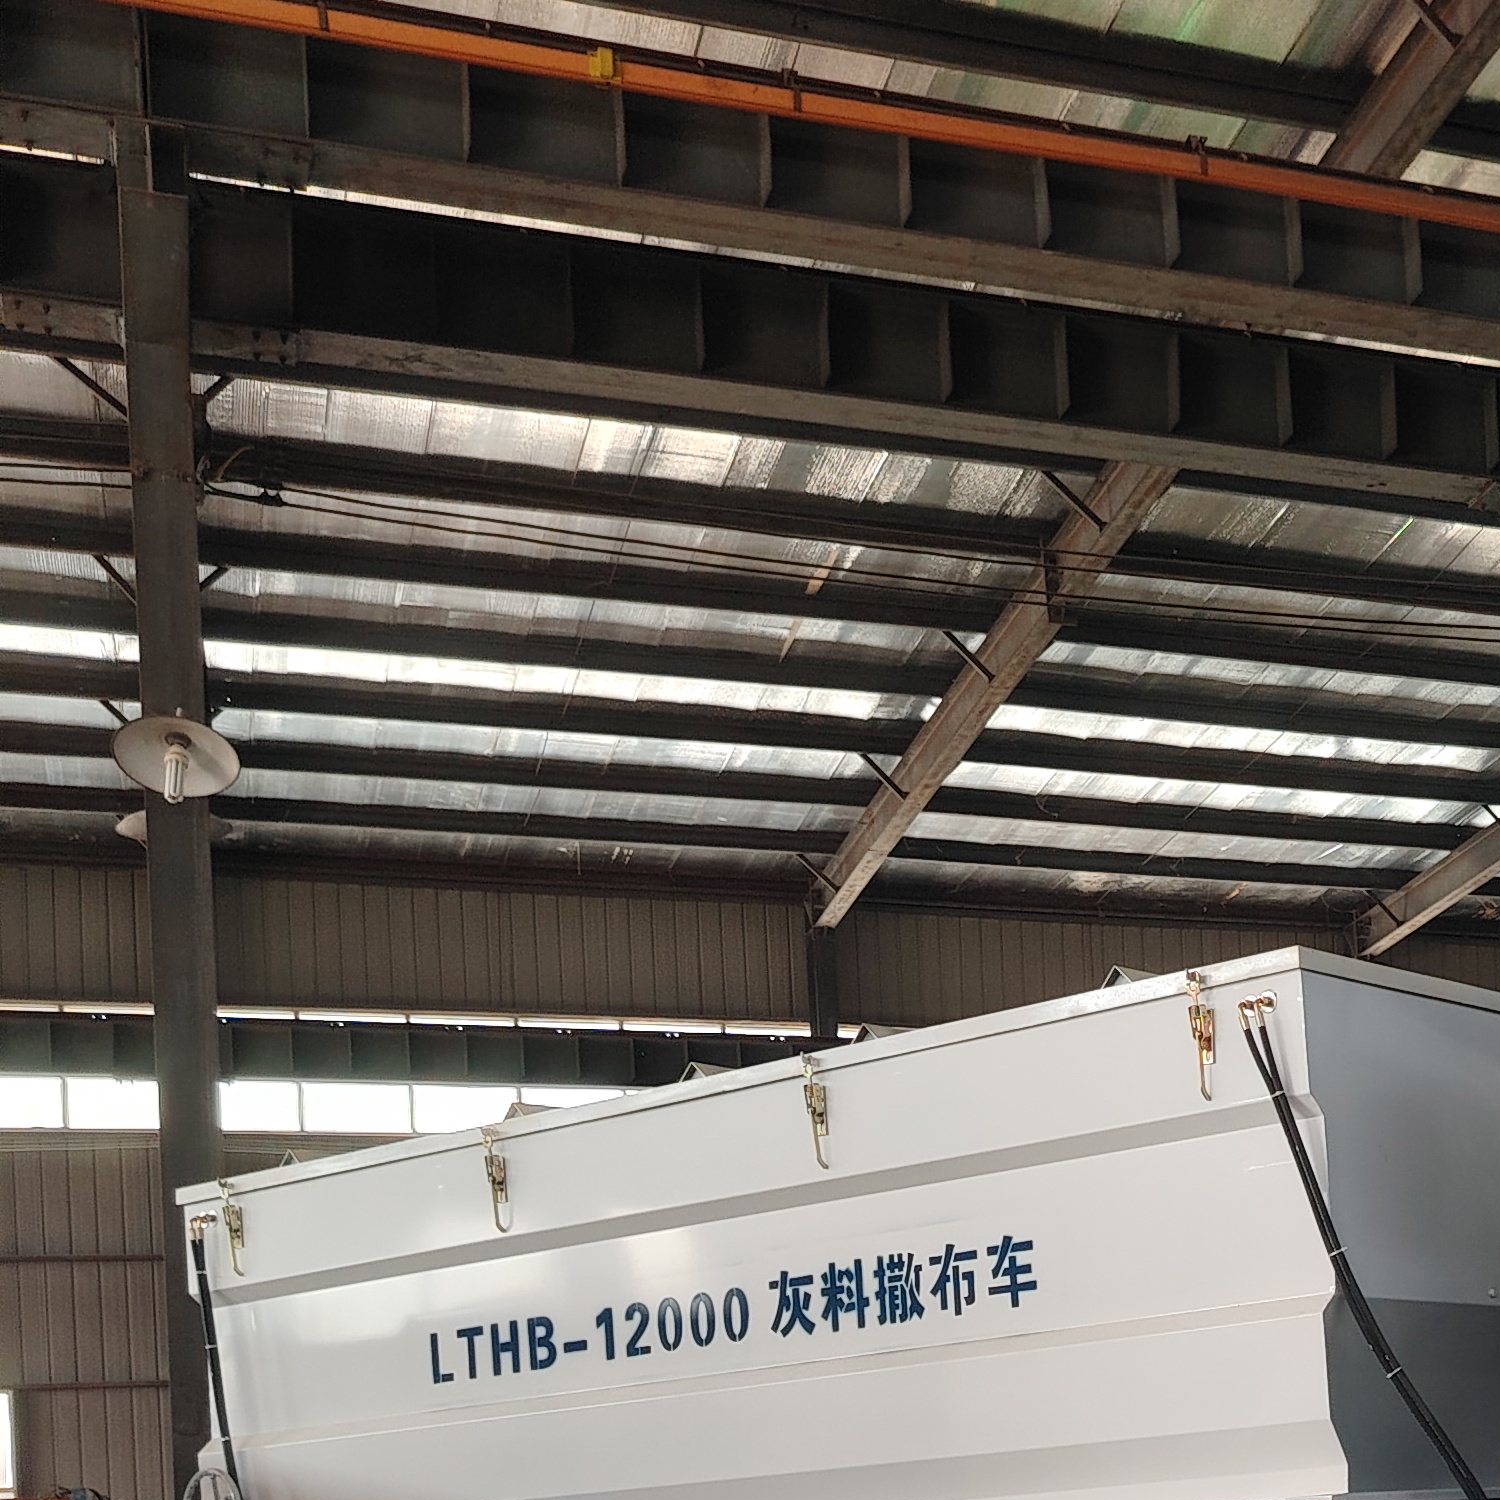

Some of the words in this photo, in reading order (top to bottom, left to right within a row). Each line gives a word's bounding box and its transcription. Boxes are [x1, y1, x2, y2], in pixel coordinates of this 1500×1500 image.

[430, 1287, 750, 1384] LTHB-12000
[768, 1235, 1038, 1338] 灰料撒布车
